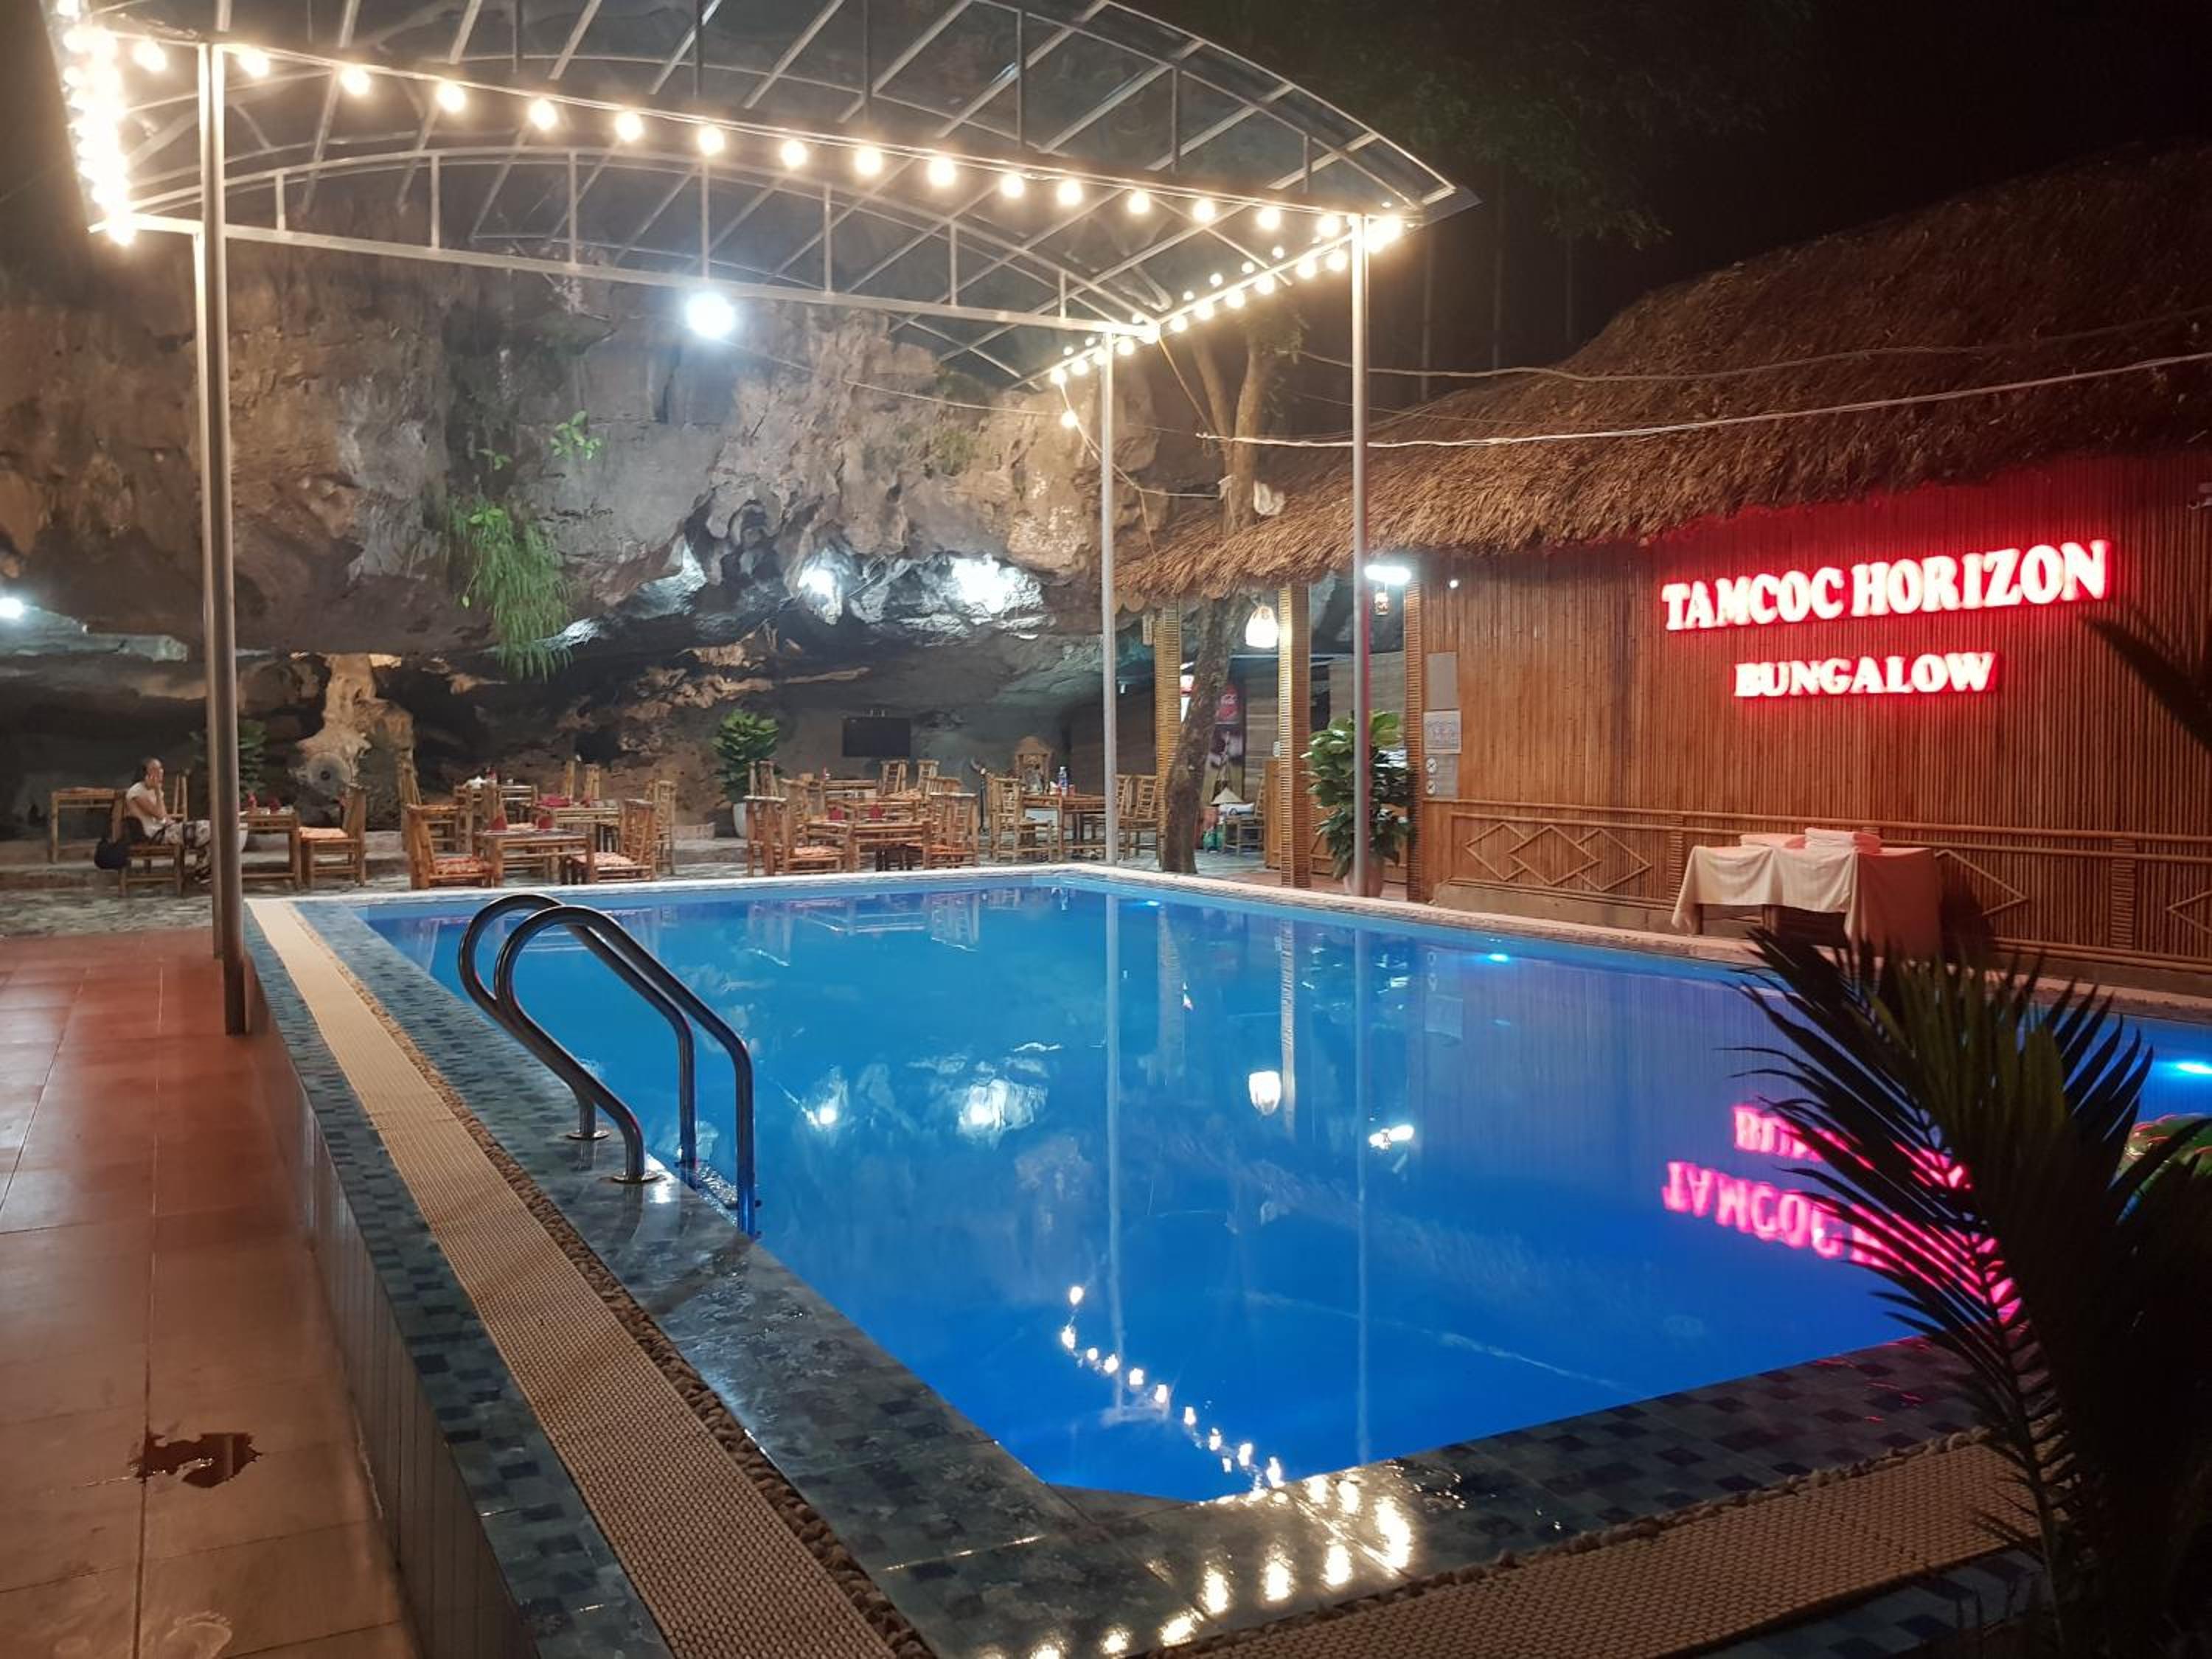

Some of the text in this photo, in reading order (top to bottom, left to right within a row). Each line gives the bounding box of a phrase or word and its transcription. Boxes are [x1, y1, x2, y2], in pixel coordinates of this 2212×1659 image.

[1661, 539, 2108, 630] TAMCOC HORIZON
[1734, 652, 1994, 697] BUNGALOW
